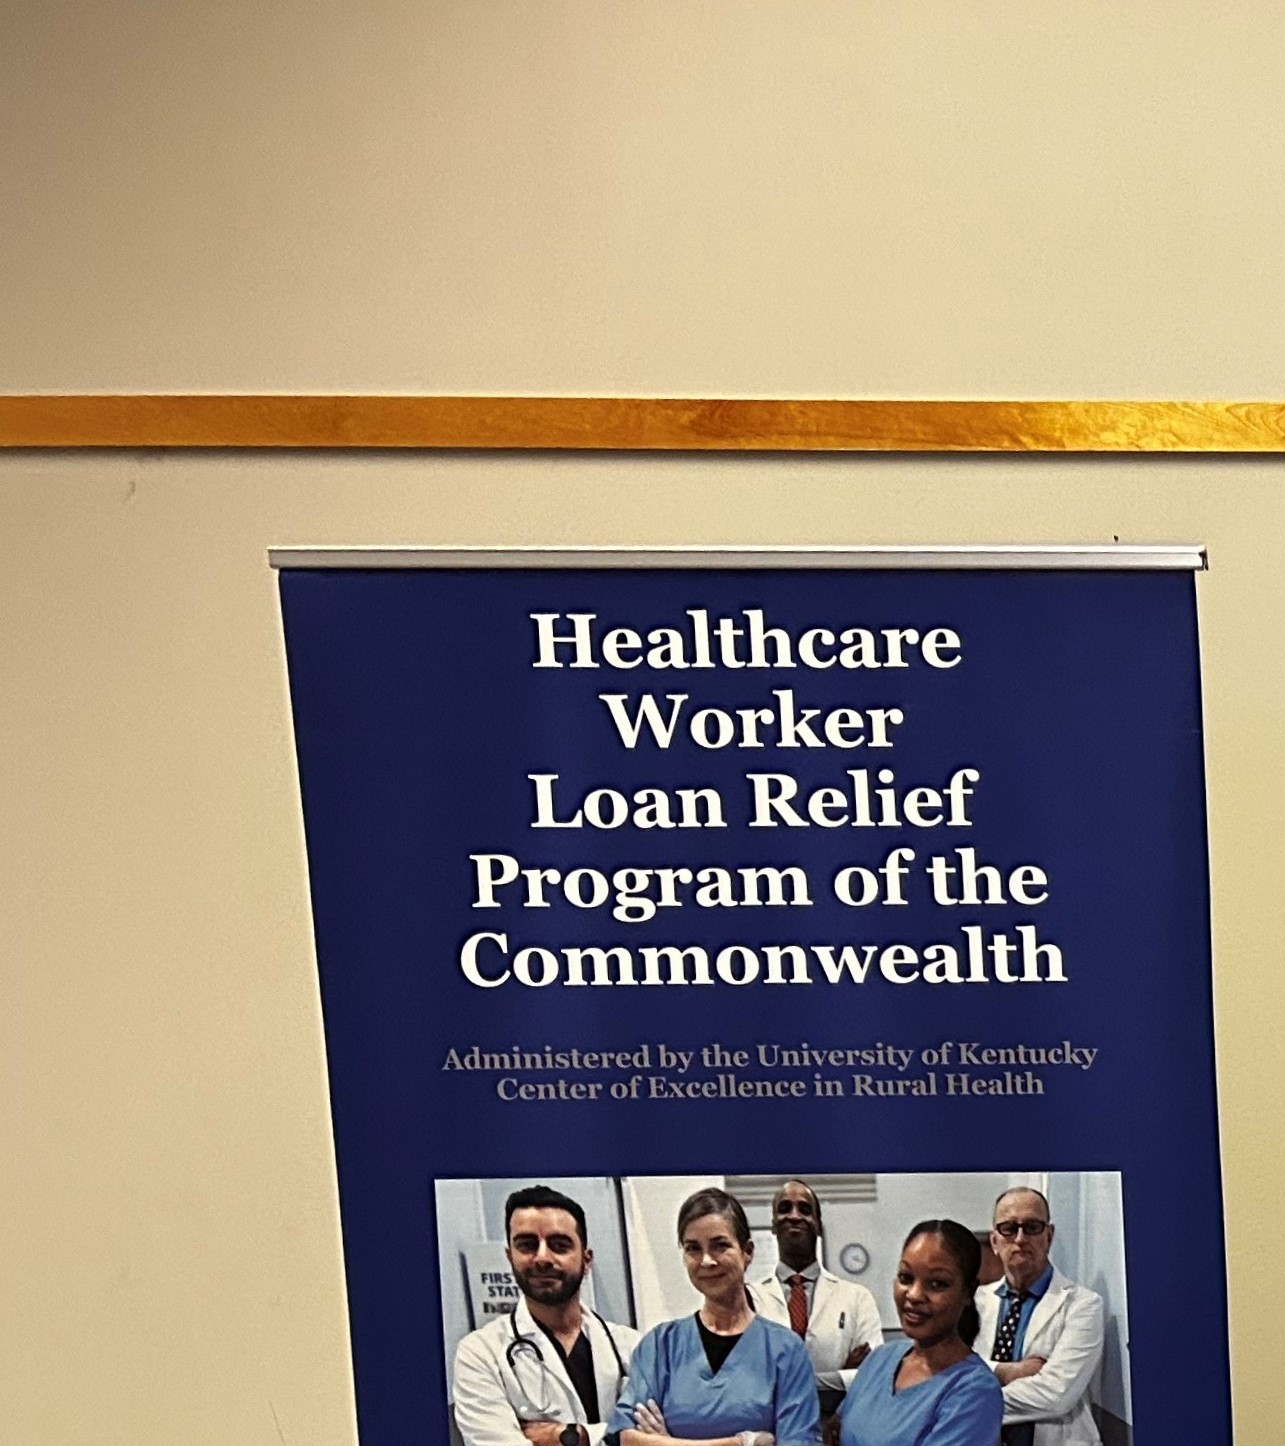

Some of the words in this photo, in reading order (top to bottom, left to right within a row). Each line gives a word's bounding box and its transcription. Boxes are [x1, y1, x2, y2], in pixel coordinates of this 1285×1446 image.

[530, 610, 961, 668] Healthcare
[599, 690, 903, 748] Worker
[528, 775, 727, 828] Loan
[746, 769, 979, 827] Relief
[470, 855, 813, 922] Program
[835, 848, 915, 906] of
[926, 848, 1048, 905] the
[461, 926, 1068, 987] Commonwealth
[442, 1045, 651, 1070] Administered
[658, 1045, 693, 1073] by
[702, 1044, 749, 1067] the
[757, 1043, 913, 1071] University
[922, 1042, 953, 1065] of
[959, 1041, 1098, 1069] Kentucky
[498, 1078, 602, 1100] Center
[611, 1075, 642, 1099] of
[648, 1074, 806, 1098] Excellence
[814, 1073, 844, 1096] in
[852, 1073, 937, 1096] Rural
[946, 1072, 1044, 1095] Health
[481, 1272, 512, 1284] FIRS
[488, 1285, 519, 1297] STAT
